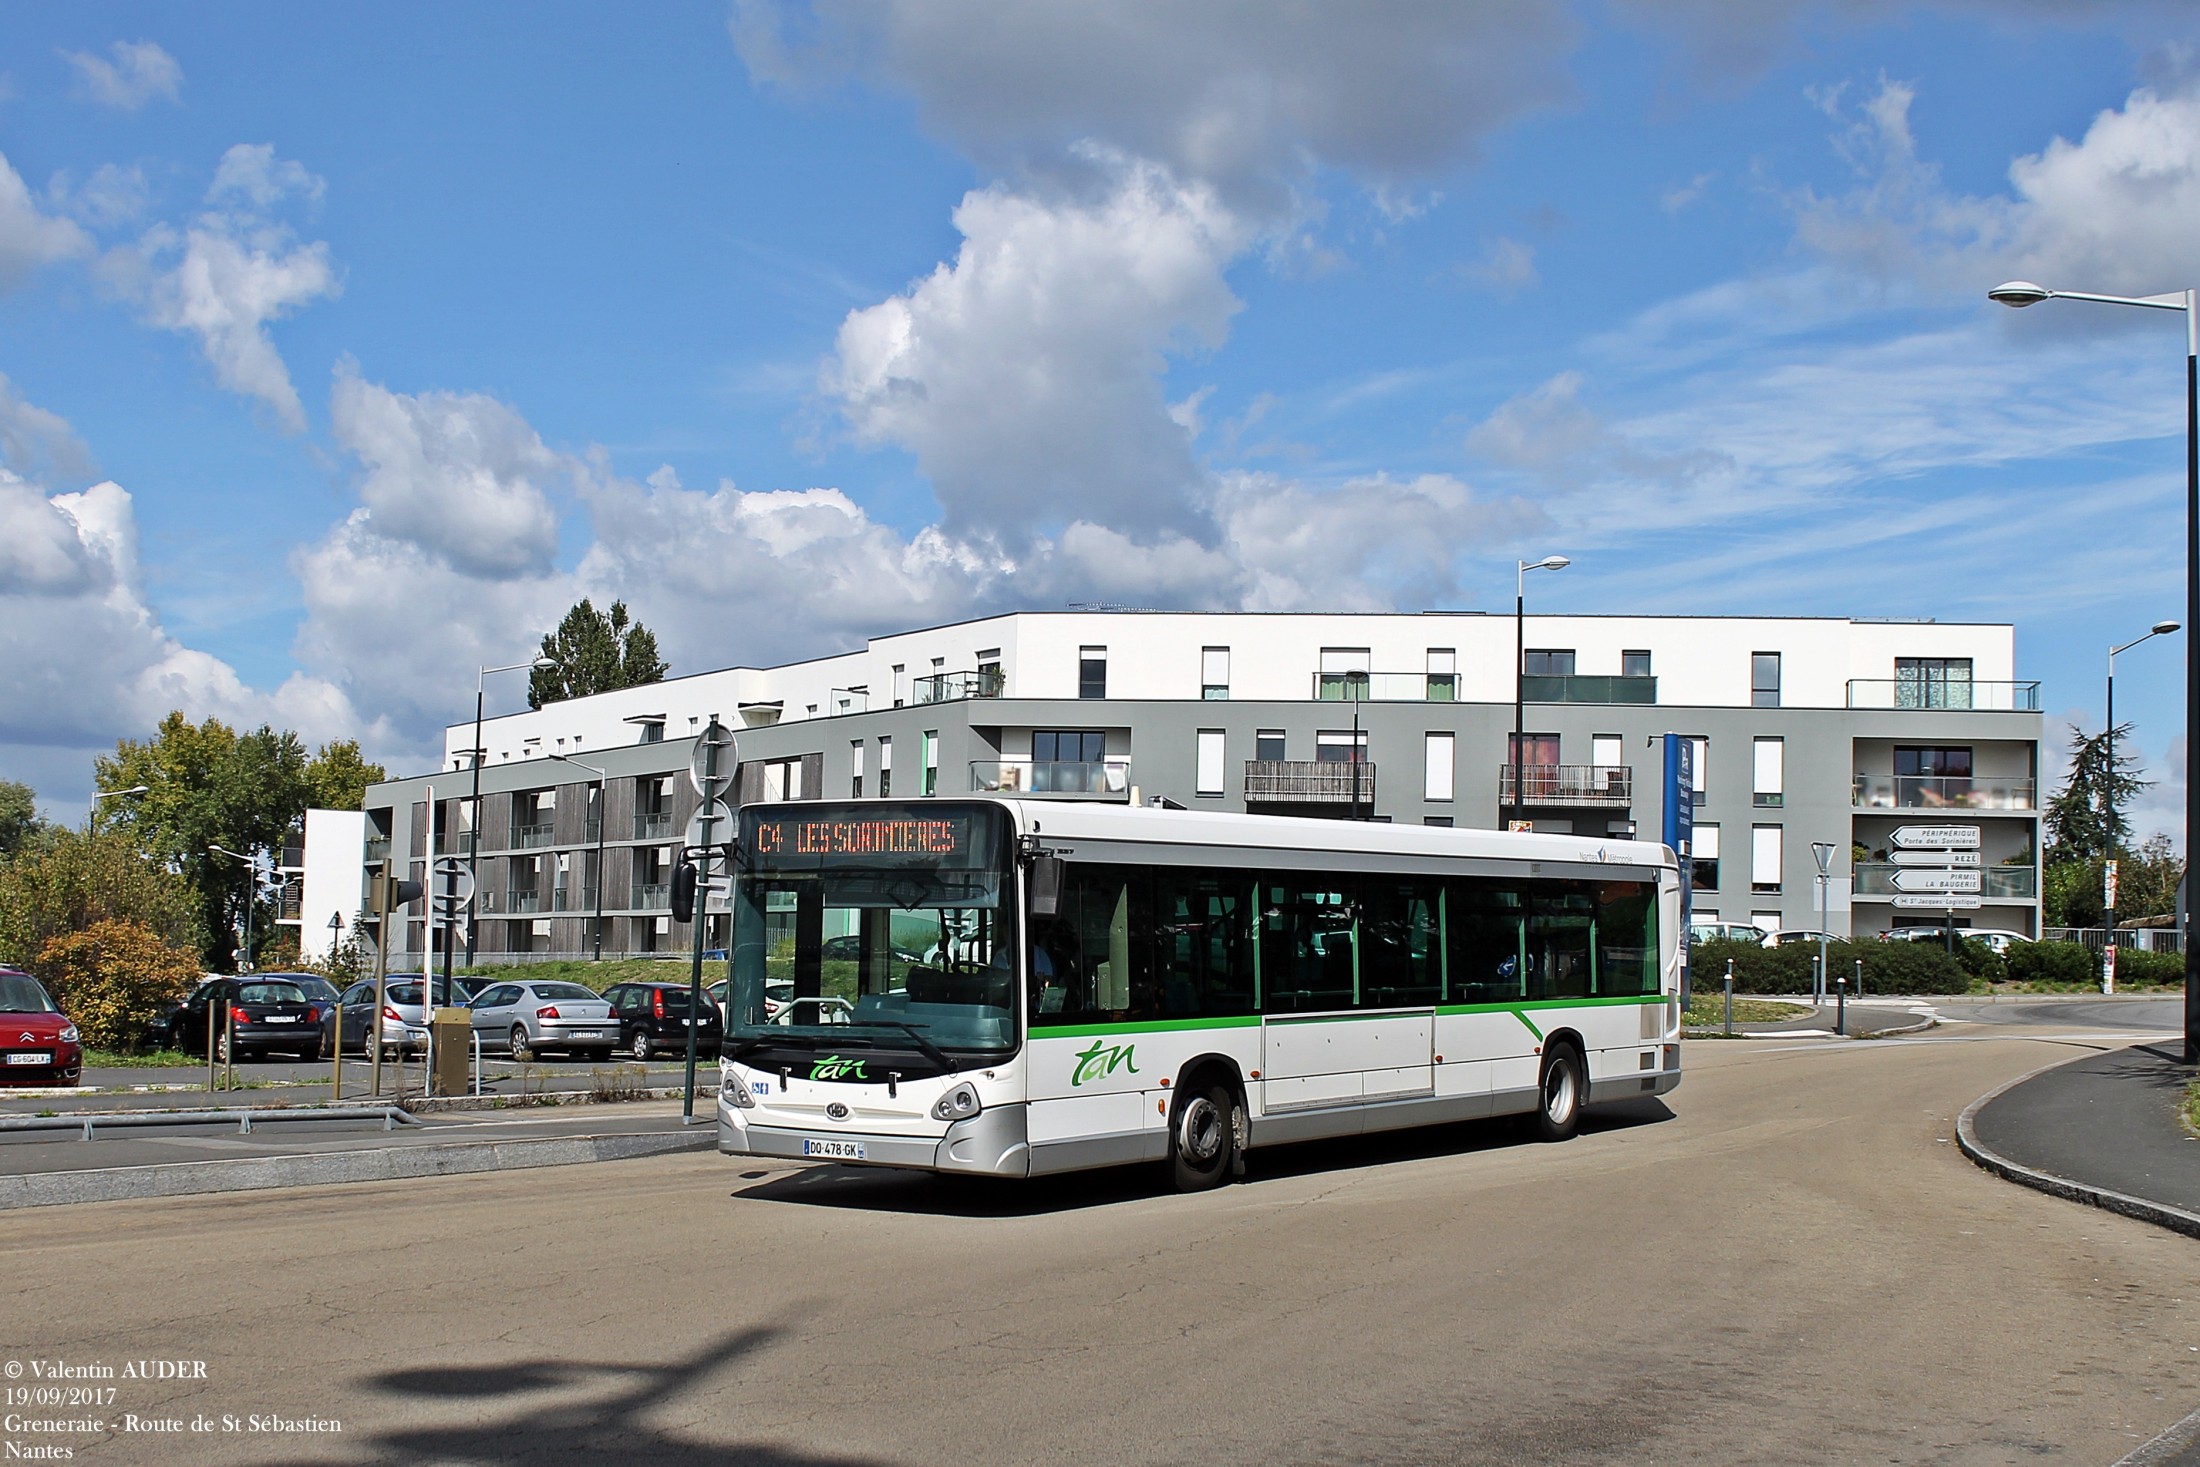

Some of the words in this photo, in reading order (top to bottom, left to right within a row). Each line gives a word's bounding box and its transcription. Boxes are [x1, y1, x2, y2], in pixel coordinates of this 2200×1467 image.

[759, 823, 783, 853] C4
[797, 823, 830, 853] LES
[1904, 837, 1923, 845] Porte
[1941, 837, 1977, 845] Sorinières
[1922, 829, 1976, 837] PÉRIPHÉRIQUE
[1950, 873, 1977, 881] PIRMIL
[809, 1055, 869, 1081] tan
[1071, 1039, 1141, 1087] tan
